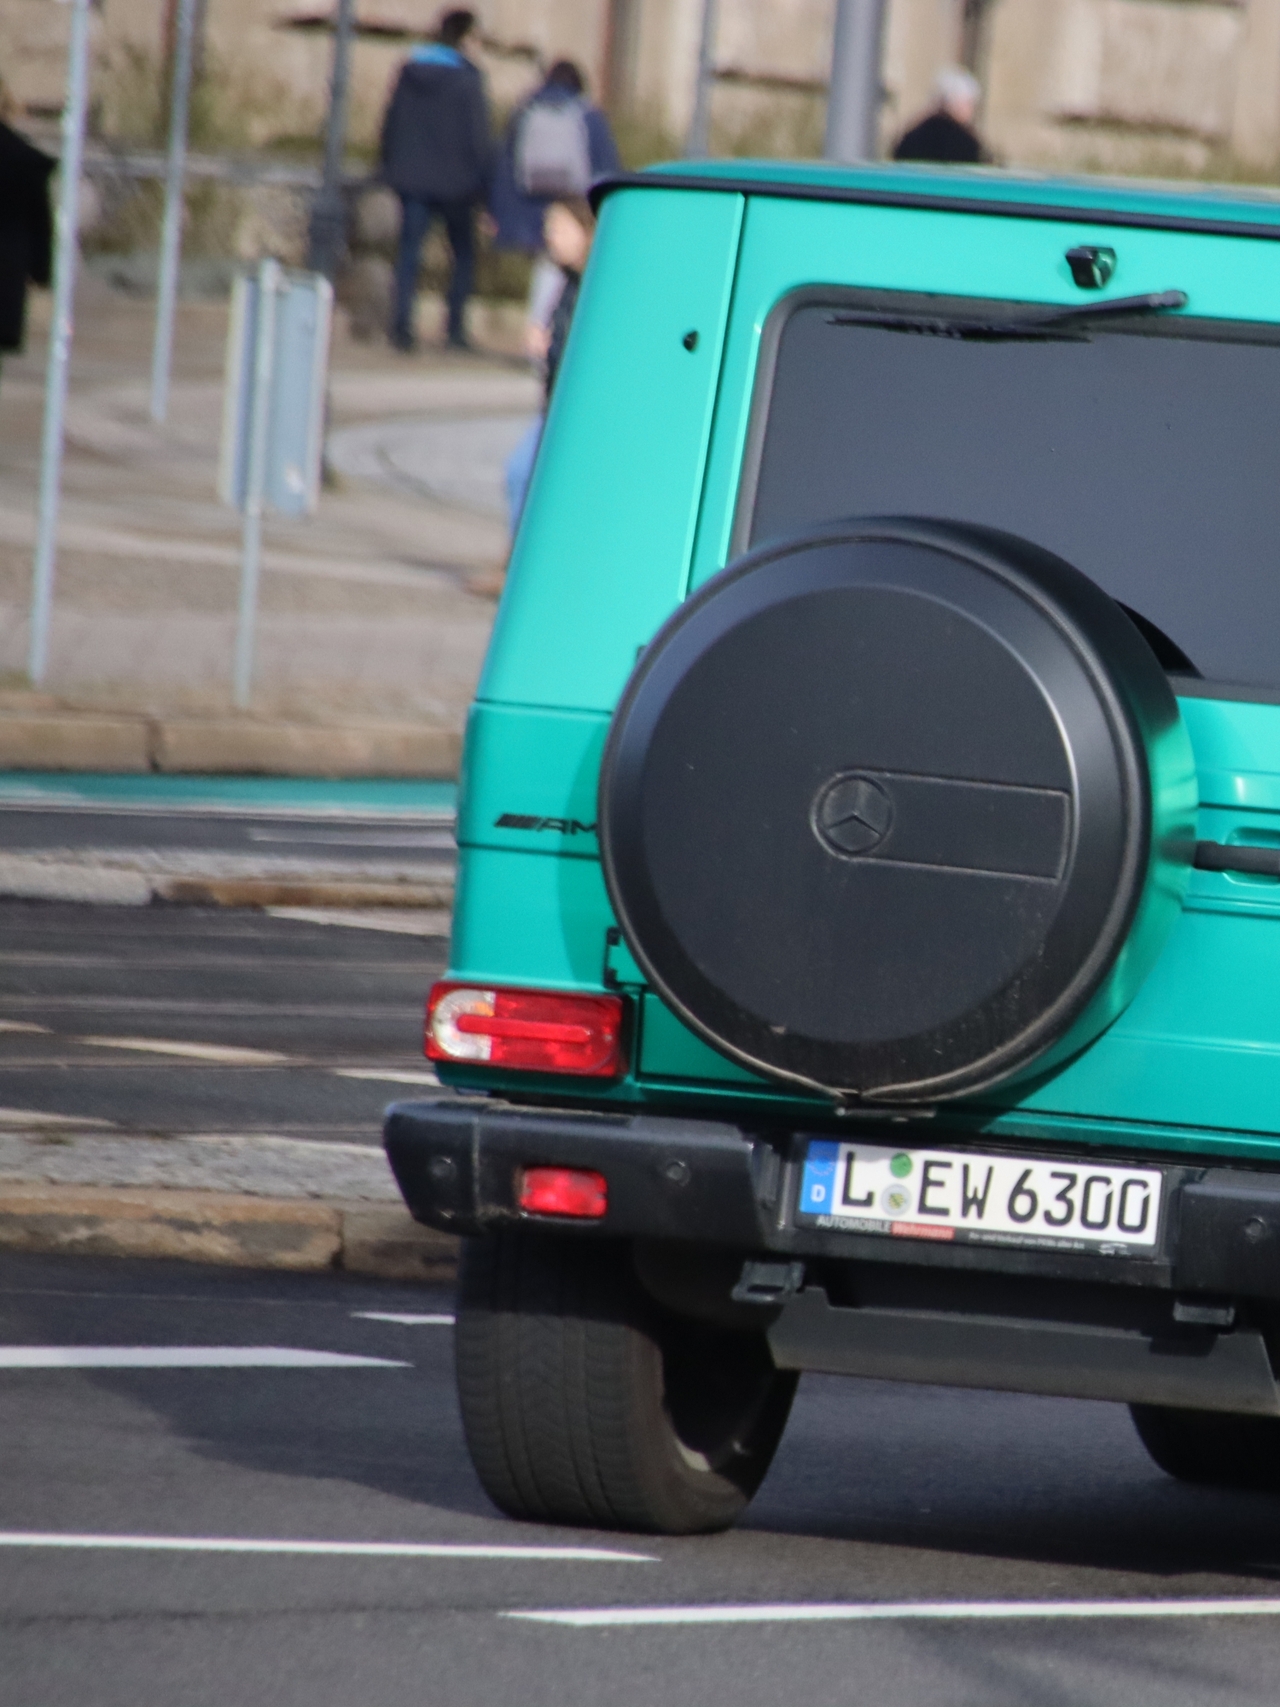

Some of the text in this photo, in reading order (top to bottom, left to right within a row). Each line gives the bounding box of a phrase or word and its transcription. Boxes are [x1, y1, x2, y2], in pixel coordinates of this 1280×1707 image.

[811, 1185, 826, 1202] D
[841, 1151, 1152, 1234] L EW 6300
[816, 1214, 892, 1233] AUTOMOBILE
